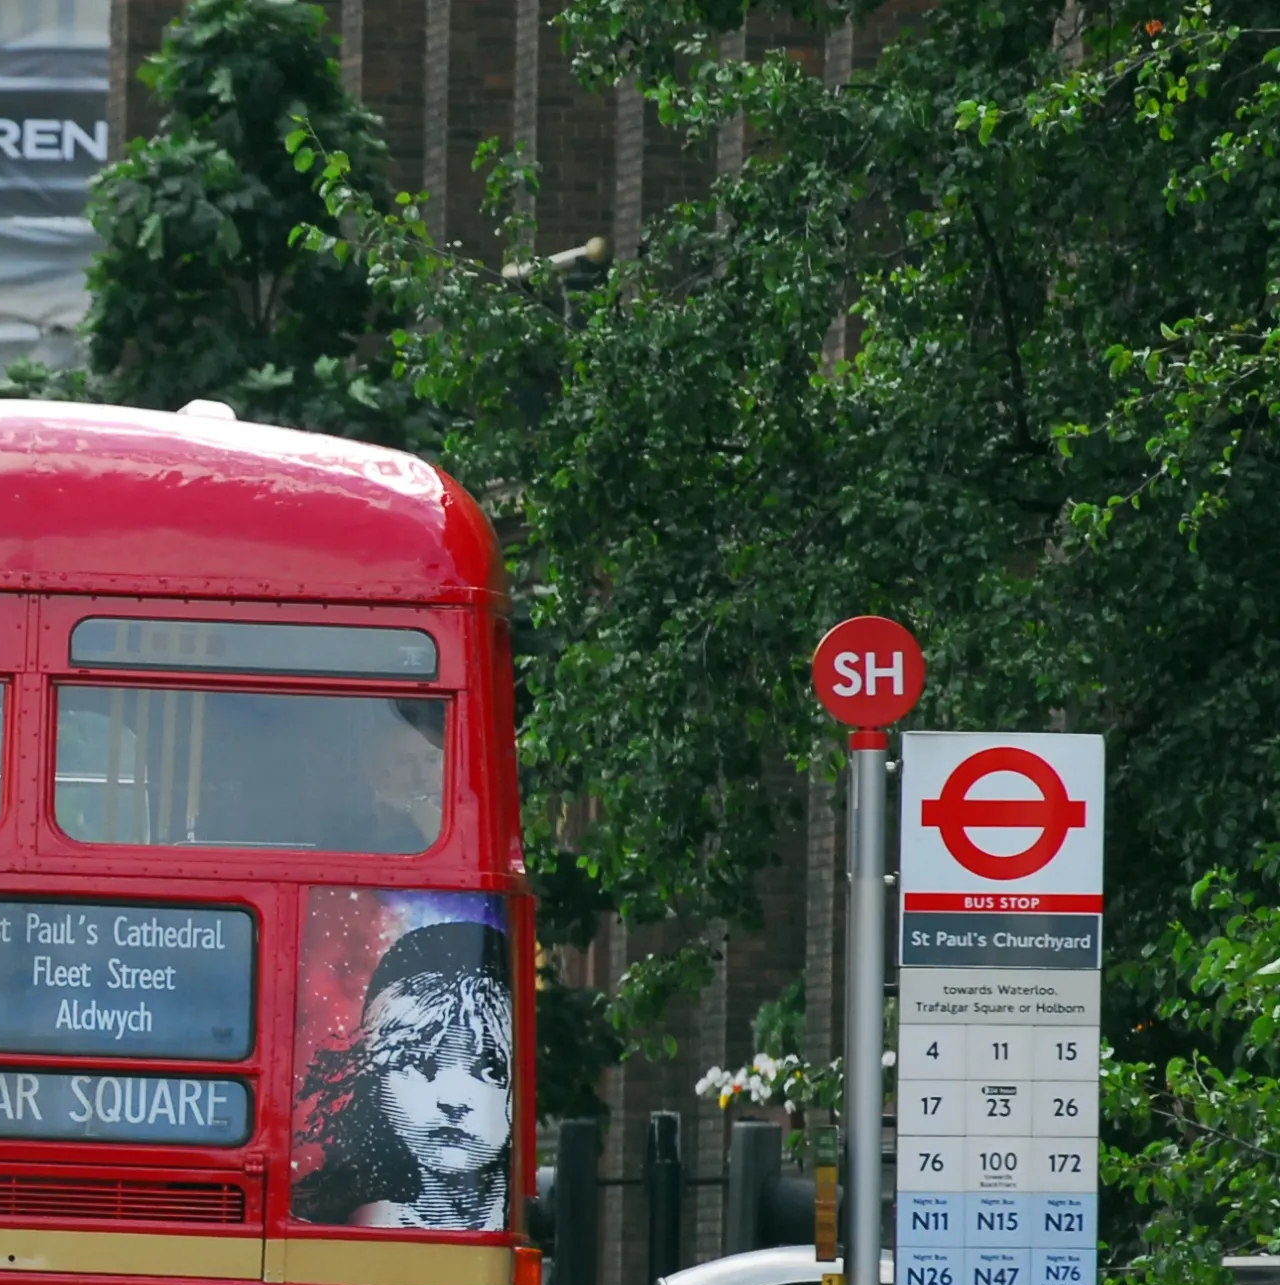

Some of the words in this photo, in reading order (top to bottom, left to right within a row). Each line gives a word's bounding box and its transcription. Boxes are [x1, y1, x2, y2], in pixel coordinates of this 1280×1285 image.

[832, 651, 904, 697] SH
[964, 897, 994, 909] BUS
[1000, 897, 1040, 909] STOP
[26, 914, 98, 946] Paul's
[114, 916, 225, 950] Cathedral
[911, 931, 930, 946] St
[936, 931, 987, 947] Paul's
[993, 932, 1091, 952] Churchyard
[33, 957, 91, 989] Fleet
[107, 959, 175, 991] Street
[943, 985, 993, 995] towards
[916, 1002, 969, 1015] Trafalgar
[974, 1002, 1015, 1015] Square
[1019, 1005, 1031, 1013] or
[1036, 1003, 1085, 1014] Holborn
[55, 1000, 153, 1039] Aldwych
[926, 1041, 939, 1060] 4
[992, 1042, 1008, 1060] 11
[1056, 1042, 1077, 1061] 15
[68, 1075, 229, 1126] SQUARE
[921, 1097, 942, 1115] 17
[987, 1099, 1011, 1117] 23
[1053, 1098, 1079, 1117] 26
[919, 1153, 944, 1172] 76
[979, 1152, 1017, 1171] 100
[1048, 1154, 1081, 1173] 172
[912, 1212, 948, 1230] N11
[977, 1212, 1018, 1231] N15
[1045, 1213, 1083, 1232] N21
[907, 1267, 953, 1285] N26
[974, 1268, 1019, 1285] N47
[1046, 1266, 1081, 1281] N76
